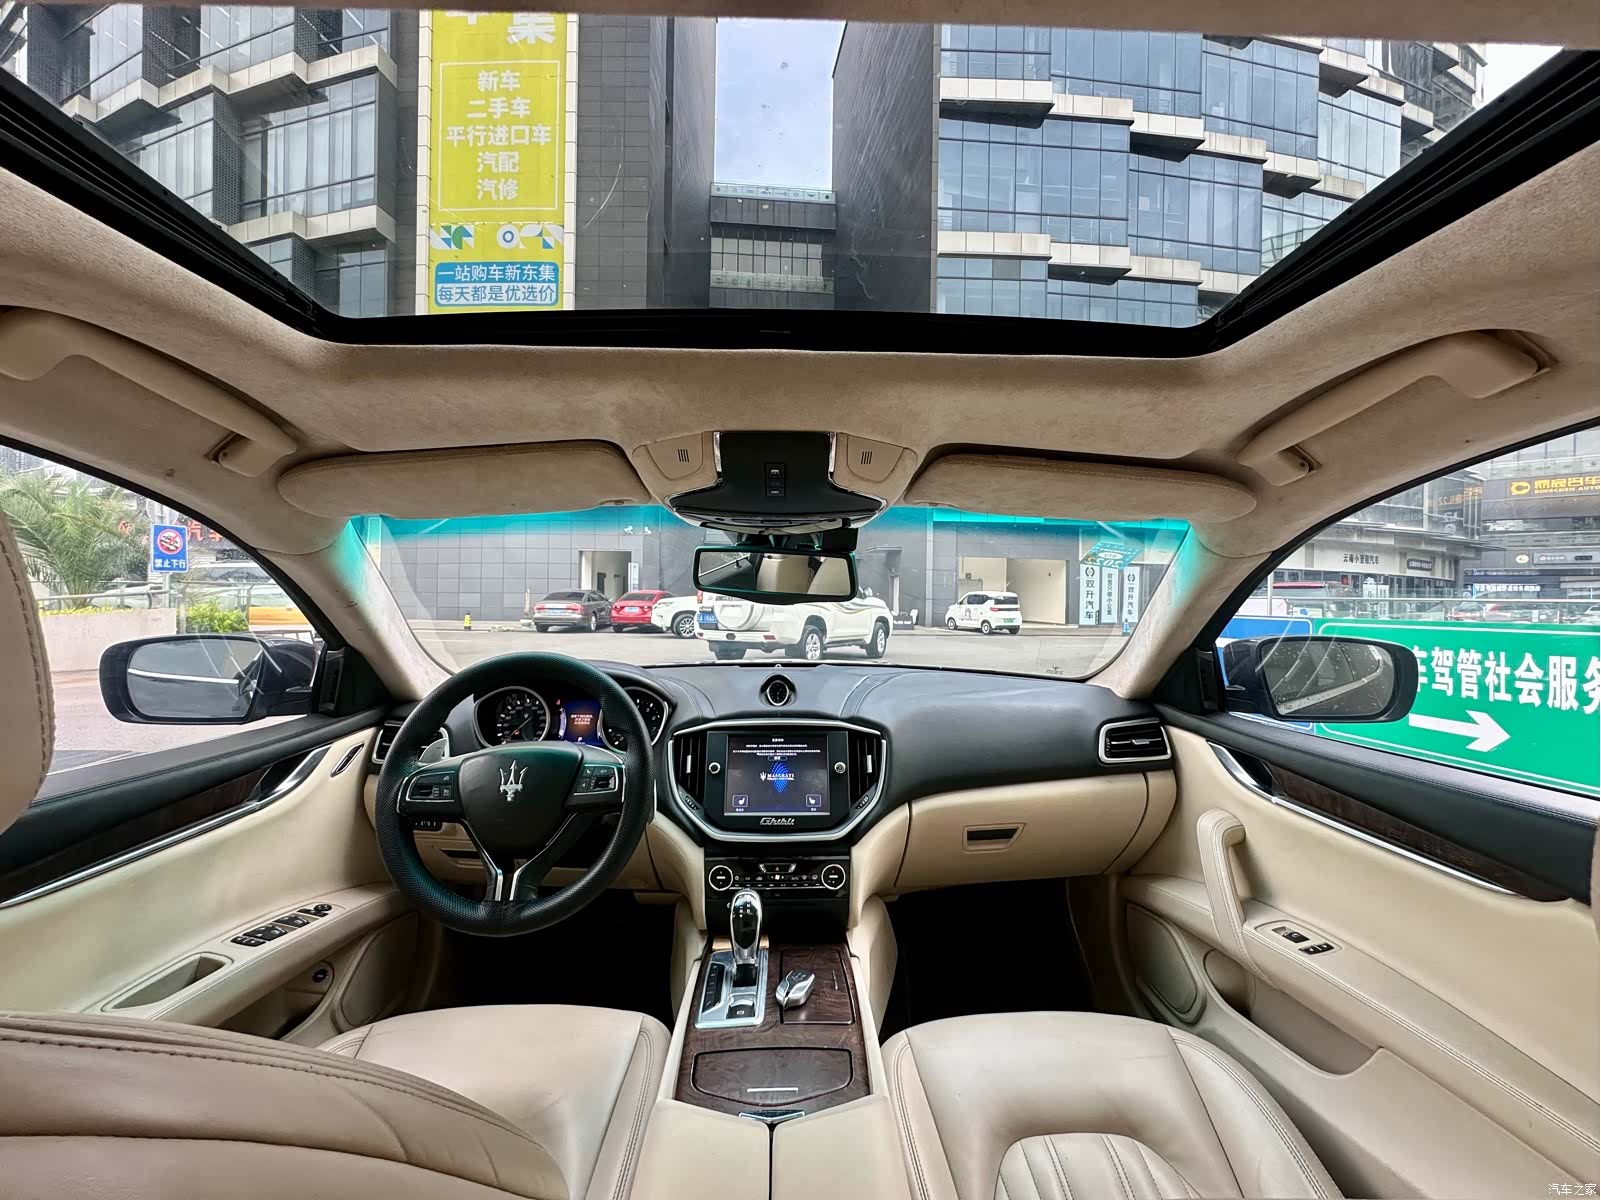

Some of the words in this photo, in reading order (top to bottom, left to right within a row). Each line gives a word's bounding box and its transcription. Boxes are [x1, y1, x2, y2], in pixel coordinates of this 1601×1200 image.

[446, 12, 557, 44] 集
[477, 70, 521, 92] 新车
[466, 98, 531, 119] 二手车
[446, 125, 552, 147] 平行进口车
[476, 151, 519, 174] 汽配
[476, 178, 519, 201] 汽修
[437, 264, 556, 282] 一站购车新东集
[438, 284, 556, 303] 每天都是优选价
[1085, 579, 1095, 619] 双升汽车
[760, 817, 795, 826] Ghibli
